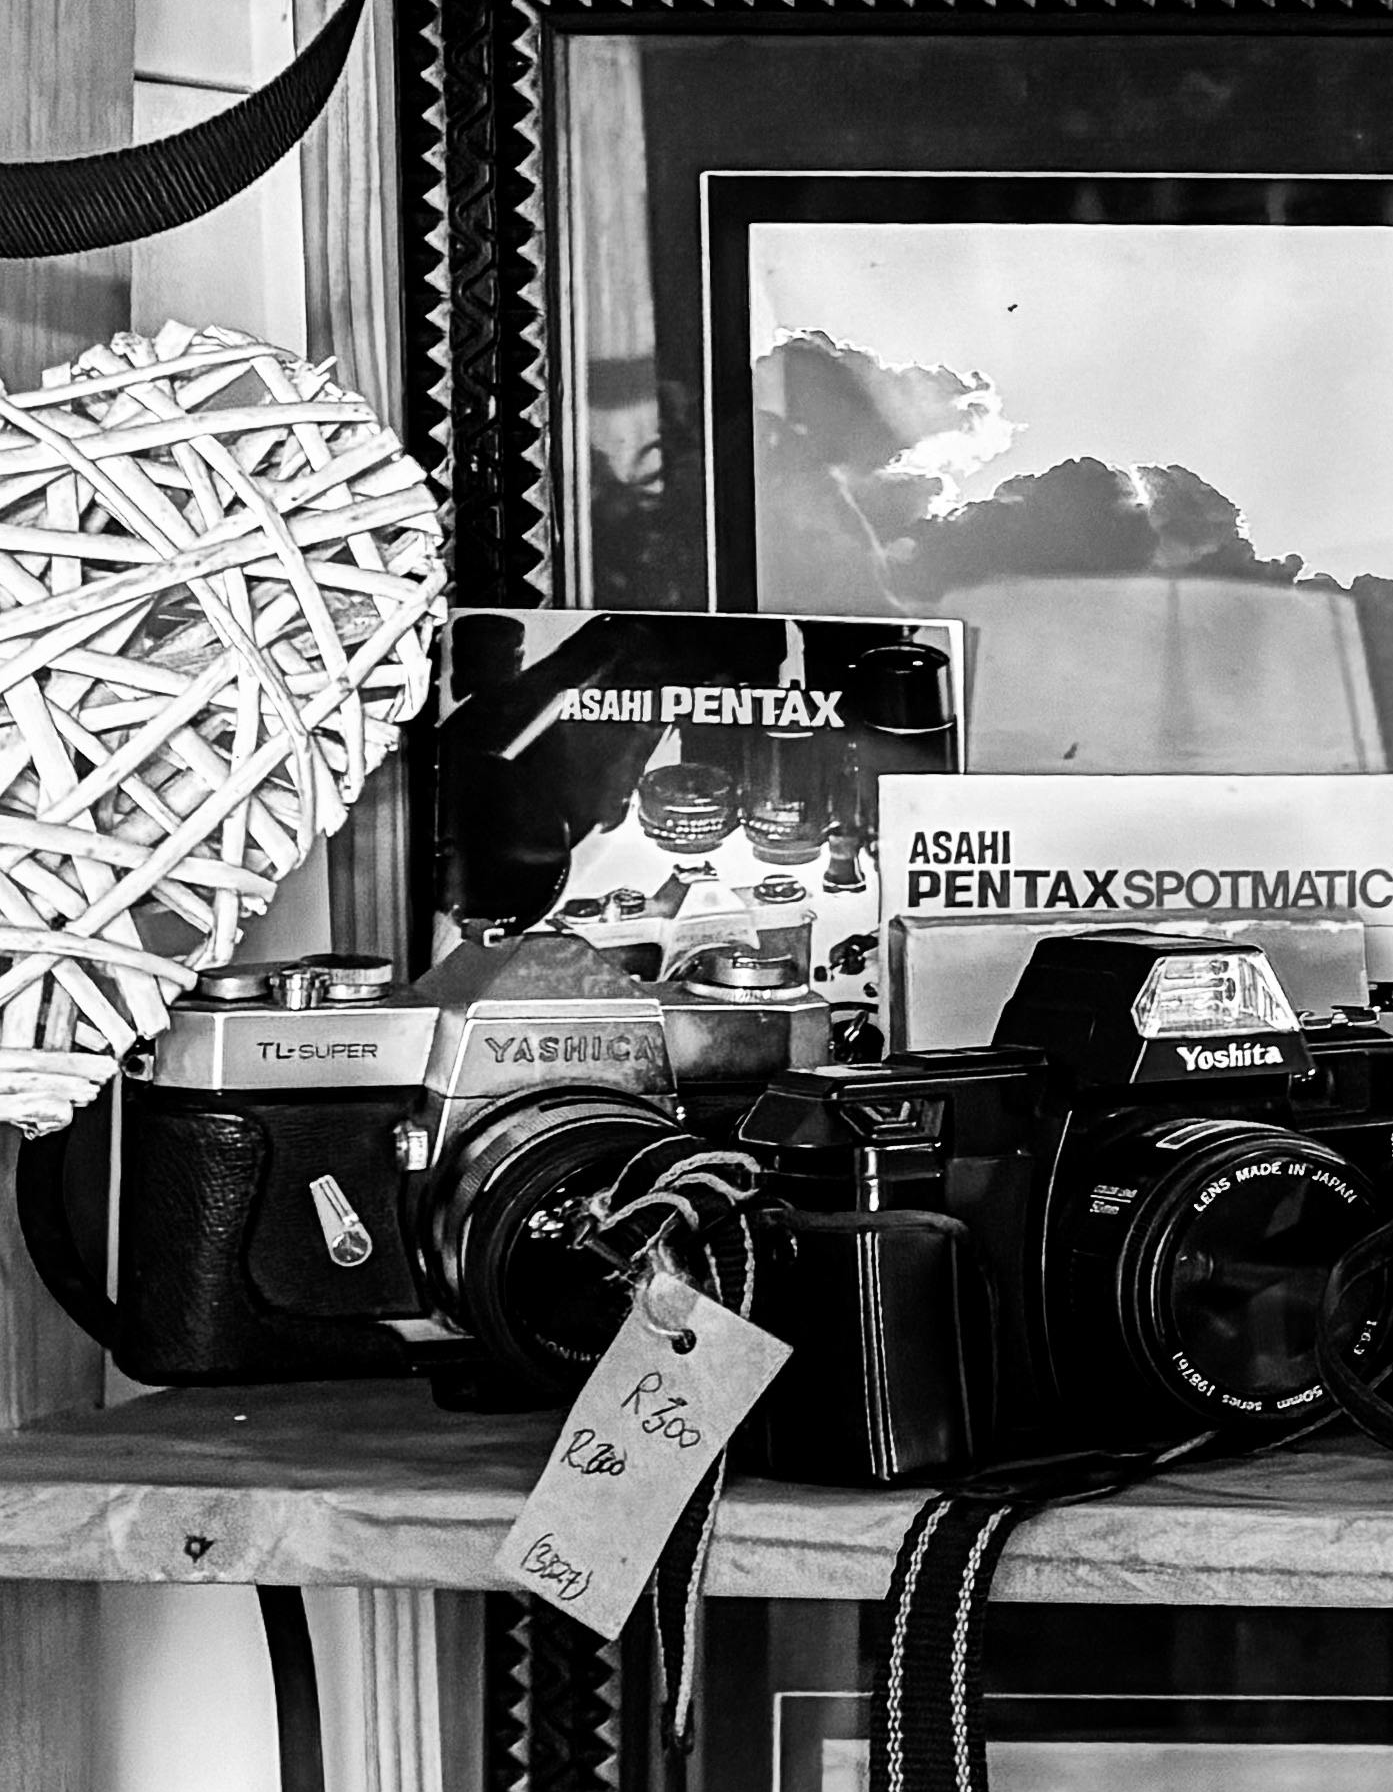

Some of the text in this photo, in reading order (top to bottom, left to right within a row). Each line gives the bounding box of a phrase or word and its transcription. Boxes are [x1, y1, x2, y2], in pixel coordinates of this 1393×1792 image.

[561, 685, 844, 728] ASAHI PENTAX
[908, 830, 1012, 866] ASAHI
[907, 870, 1119, 908] PENTAX
[1123, 869, 1393, 909] SPOTMATIC
[257, 1042, 379, 1061] TL-SUPER
[484, 1034, 662, 1066] YASHICA
[1177, 1043, 1284, 1072] Yoshita
[1193, 1161, 1358, 1213] LENS MADE IN JAPAN
[1276, 1384, 1324, 1410] 50mm
